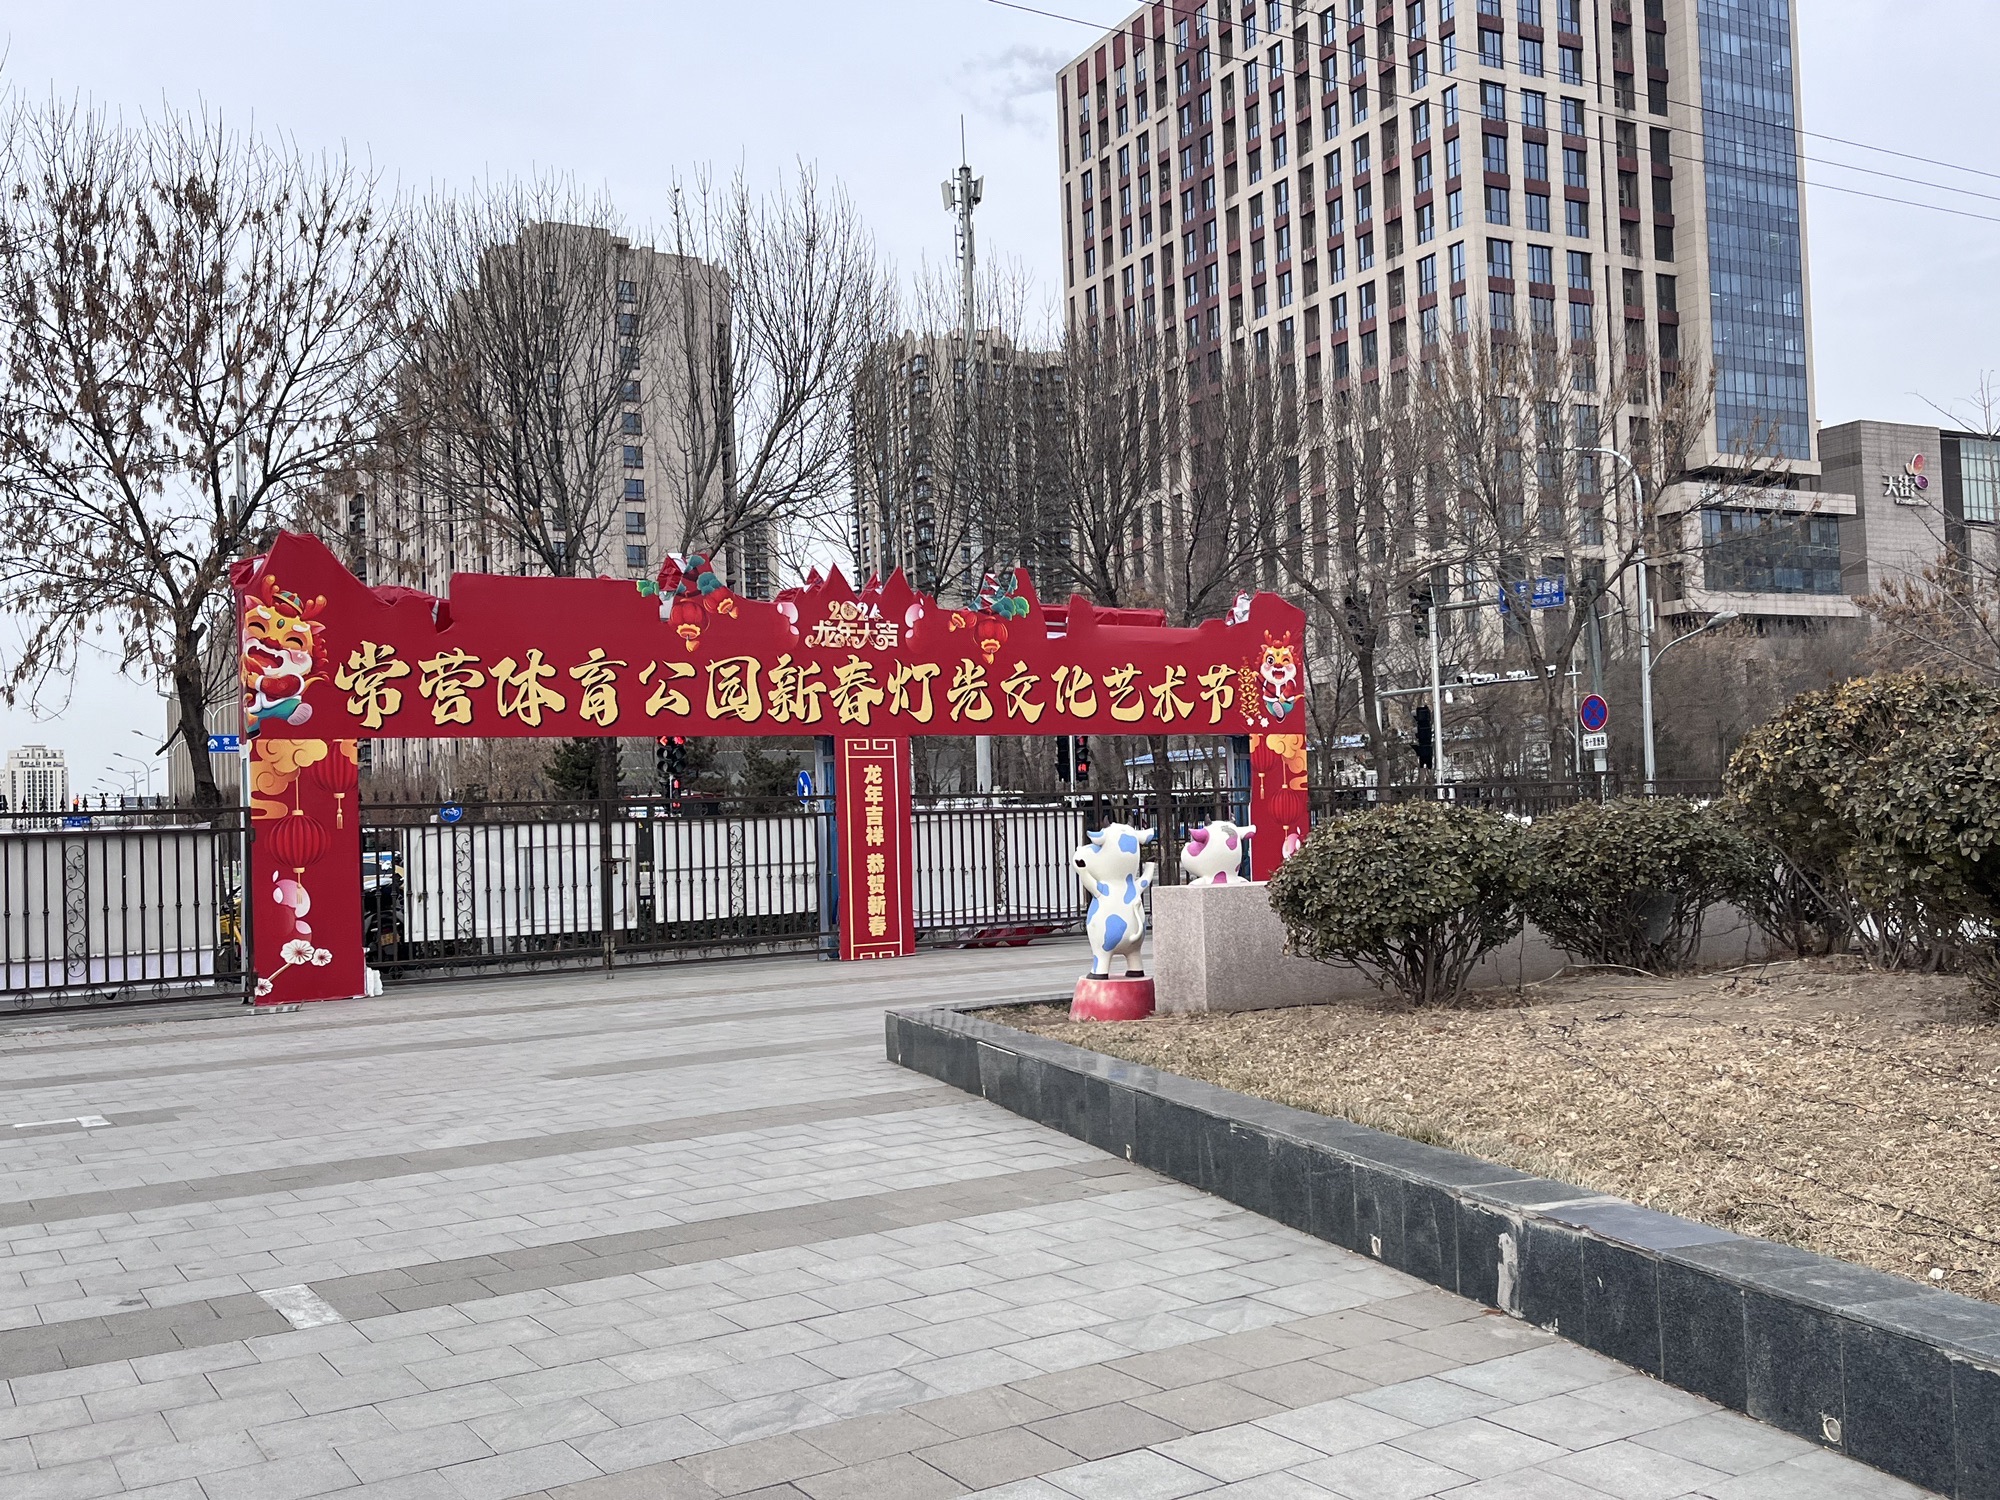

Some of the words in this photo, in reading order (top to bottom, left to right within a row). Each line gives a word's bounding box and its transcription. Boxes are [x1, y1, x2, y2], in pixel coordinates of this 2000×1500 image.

[804, 620, 899, 651] 龙年大吉
[828, 600, 884, 620] 2024
[334, 639, 1238, 730] 常营体育公园新春灯光文化艺术节
[863, 764, 885, 847] 龙年吉祥
[866, 853, 887, 937] 恭贺新春
